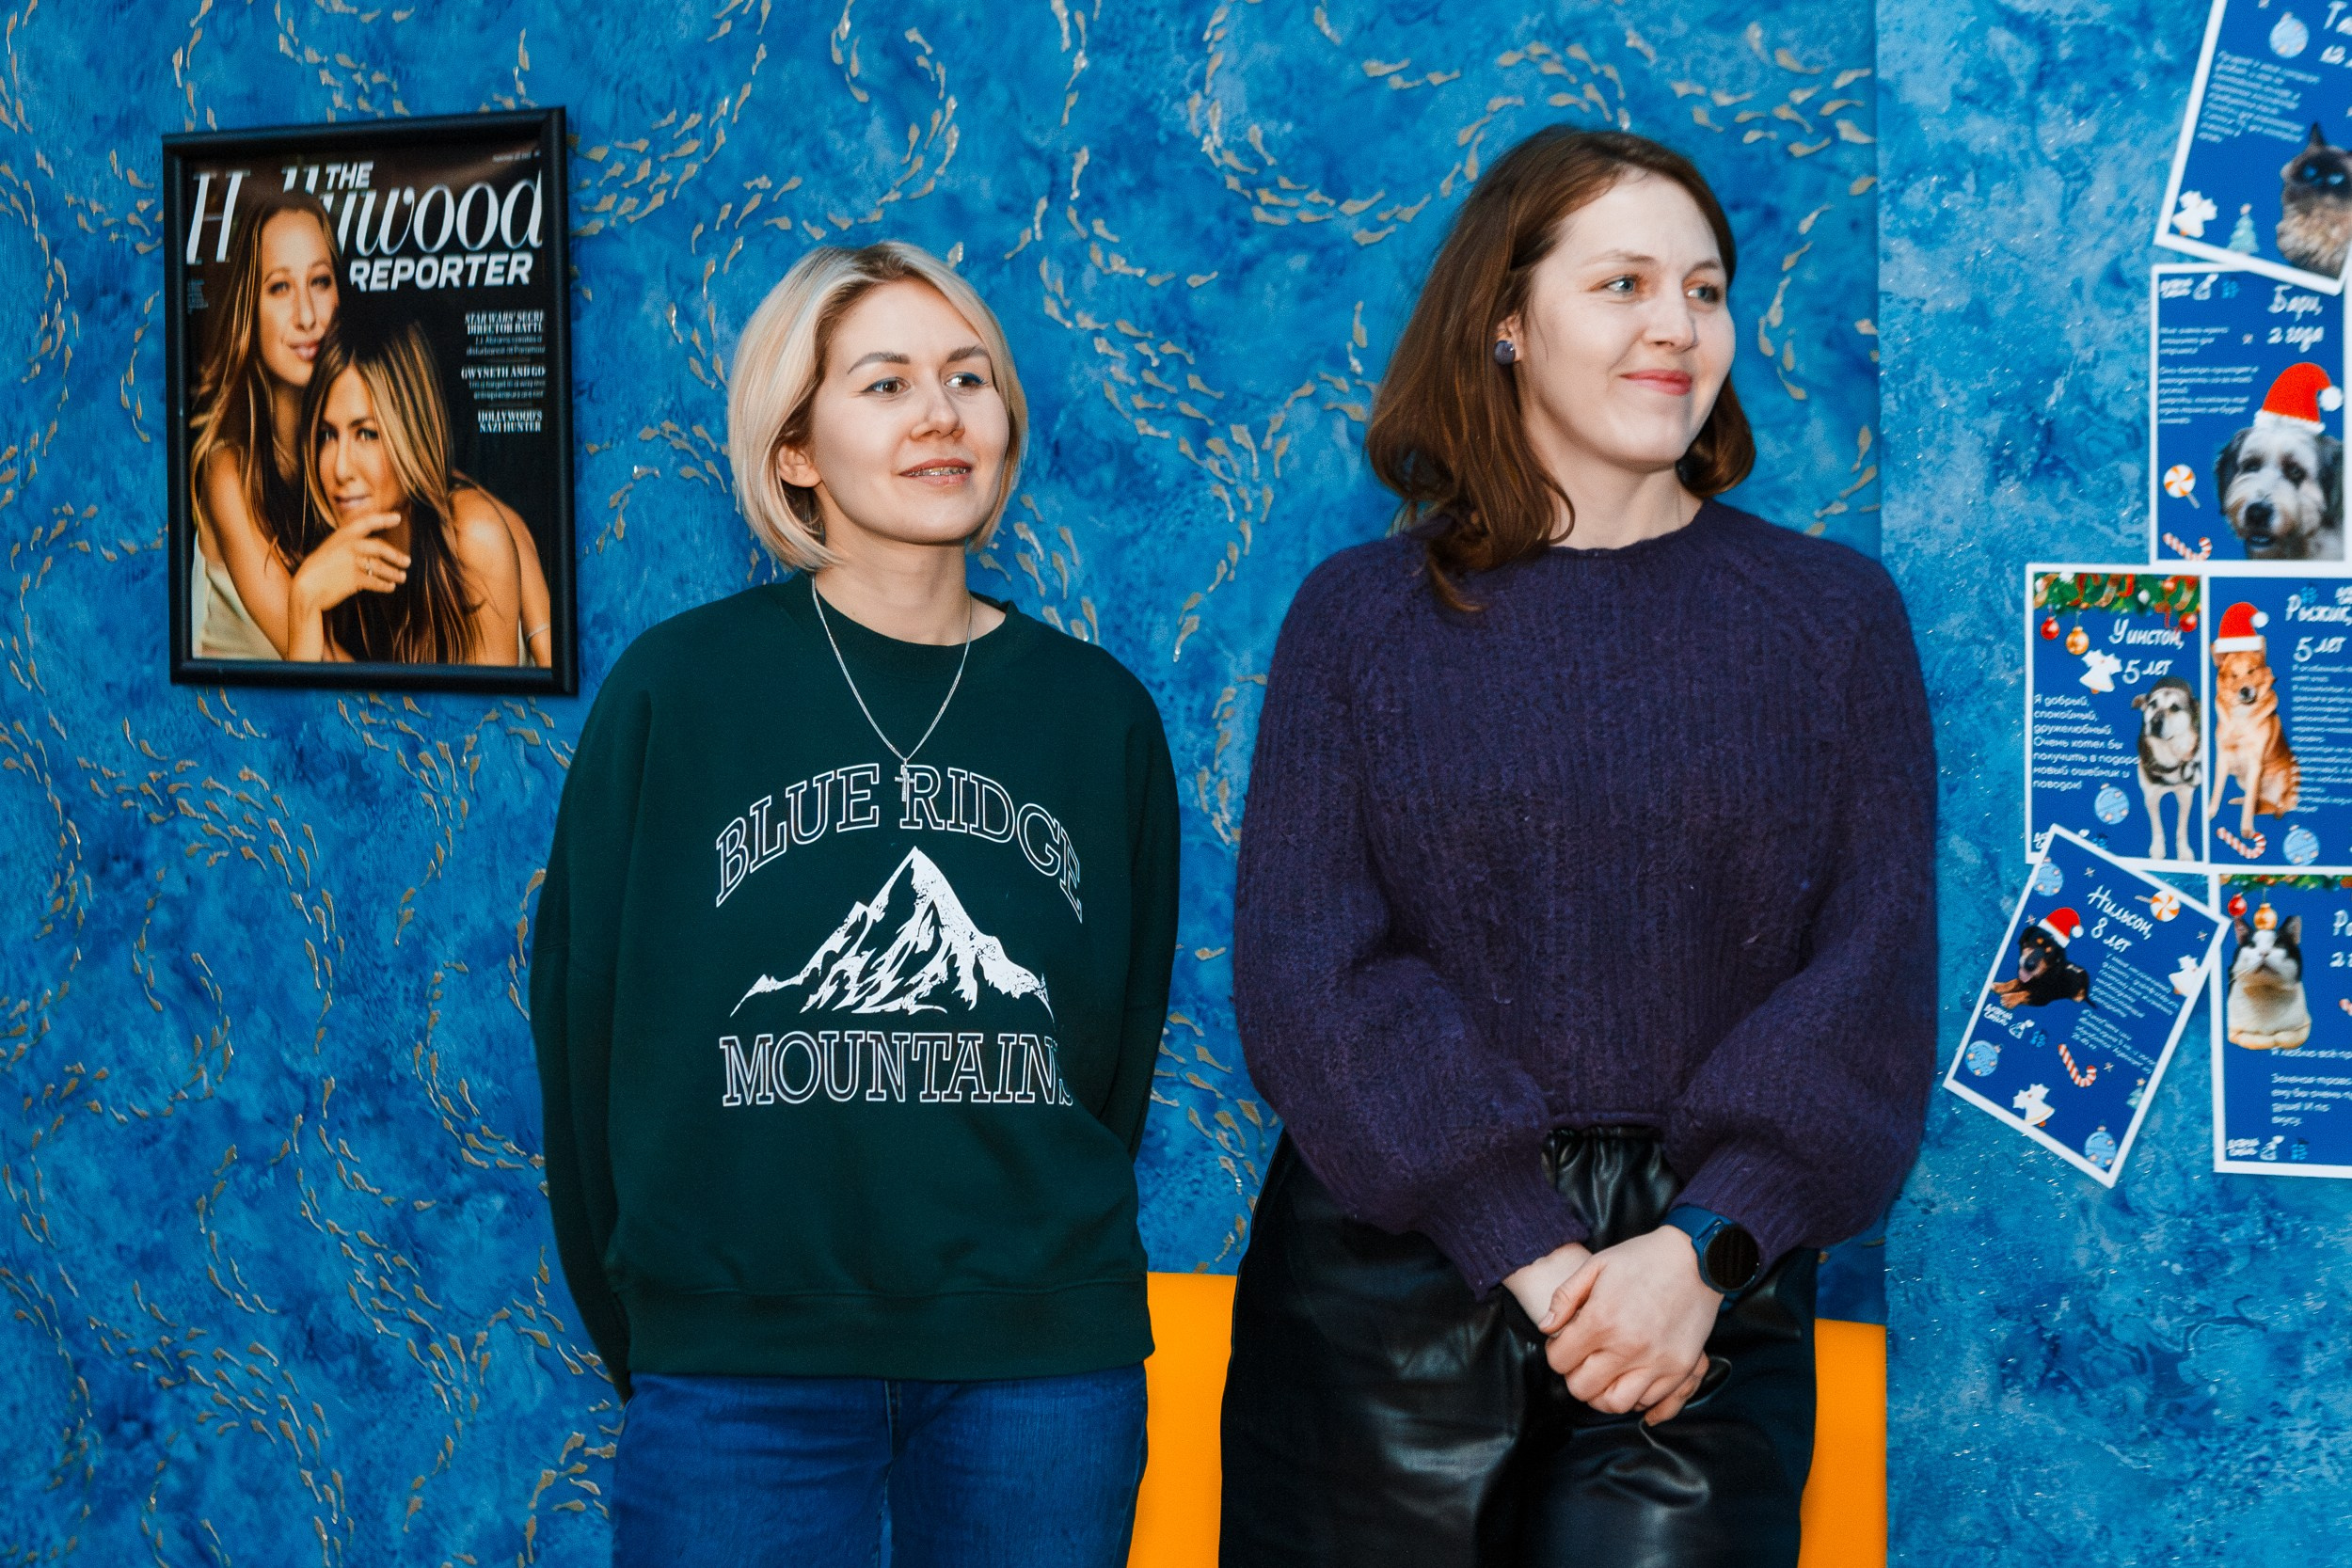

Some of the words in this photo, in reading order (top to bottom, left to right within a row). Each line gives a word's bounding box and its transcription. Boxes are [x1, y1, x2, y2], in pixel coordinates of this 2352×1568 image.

[326, 160, 374, 189] THE
[186, 166, 543, 266] Hywood
[349, 251, 533, 292] REPORTER
[2267, 327, 2283, 344] 2
[510, 365, 530, 378] AND
[2108, 618, 2185, 651] Уинстон,
[2293, 636, 2314, 662] 5
[2312, 636, 2347, 654] лет
[2122, 658, 2141, 685] 5
[2141, 658, 2174, 675] лет
[716, 763, 880, 908] BLUE
[899, 764, 1083, 924] RIDGE
[2087, 884, 2154, 941] Нильсон,
[2090, 916, 2109, 939] 8
[2103, 934, 2134, 953] лет
[2329, 951, 2345, 968] 2
